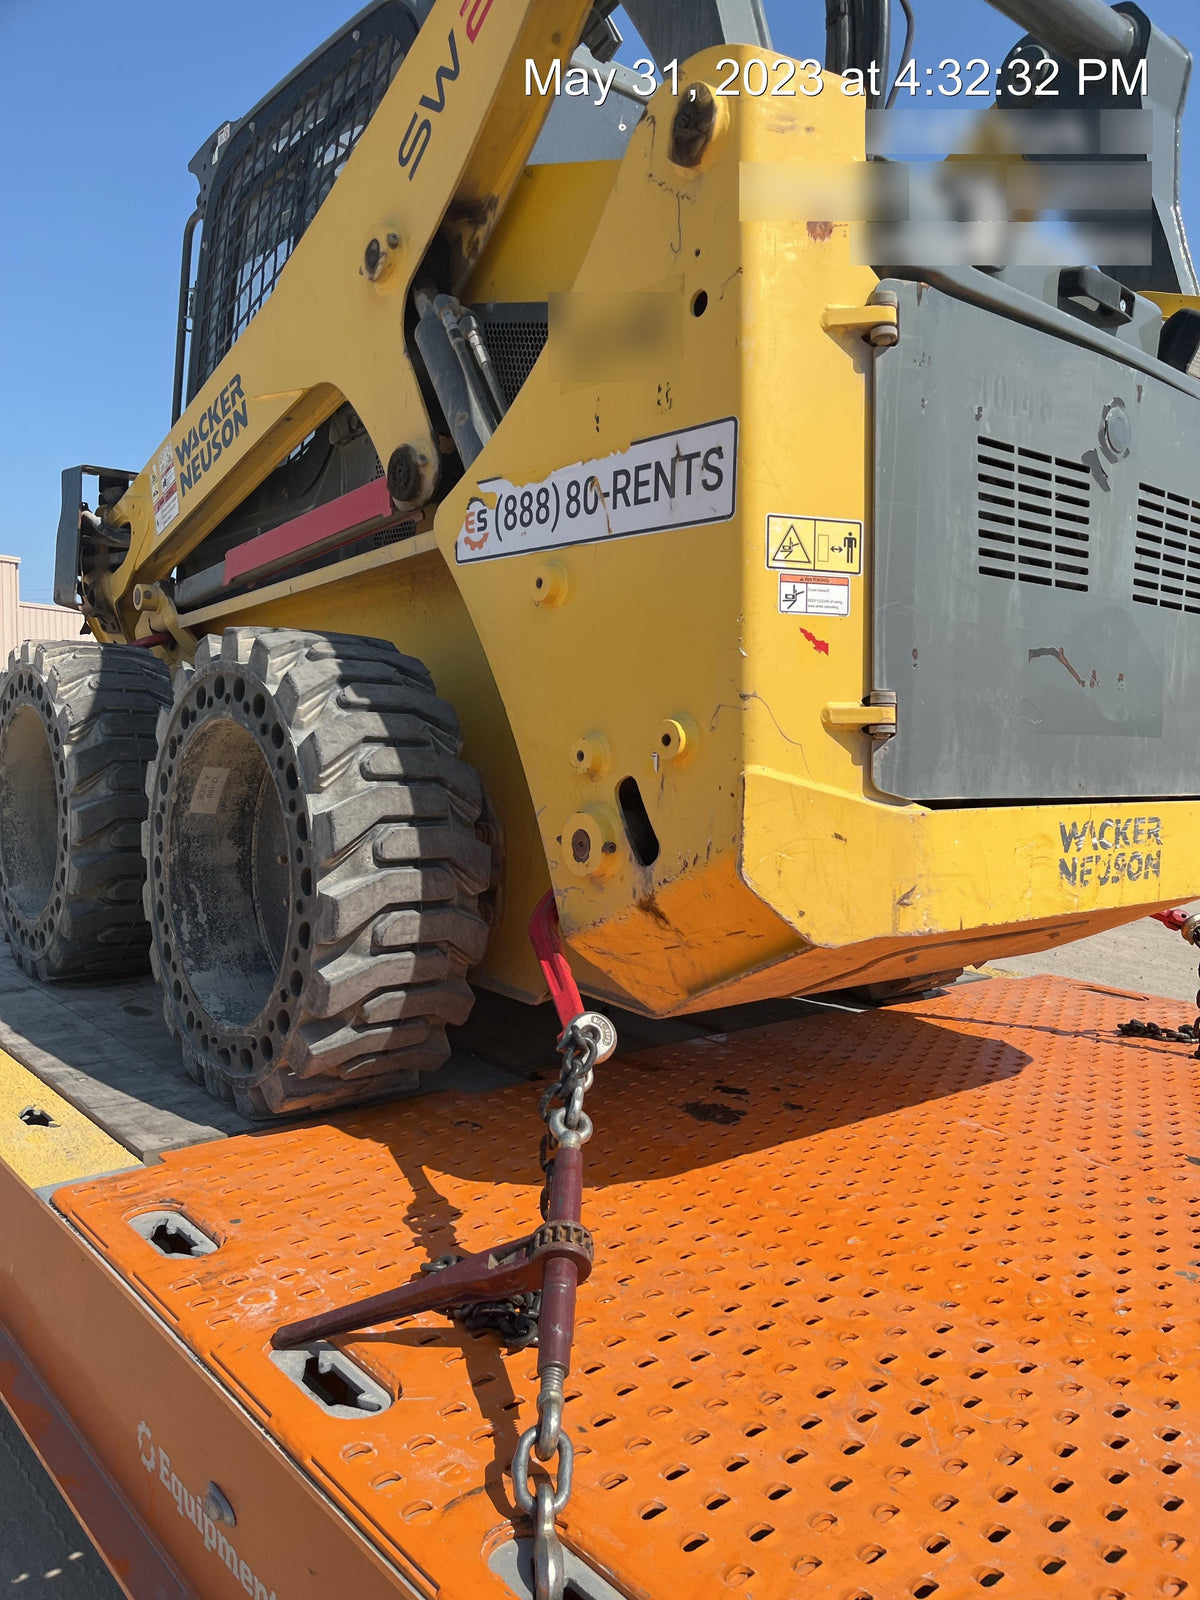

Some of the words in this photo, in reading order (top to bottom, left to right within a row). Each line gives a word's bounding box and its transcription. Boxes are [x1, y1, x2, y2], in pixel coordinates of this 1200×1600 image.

[174, 373, 245, 468] WACKER
[179, 399, 249, 498] NEUSON
[1059, 815, 1163, 853] WACKER
[158, 1446, 277, 1600] Equipmen
